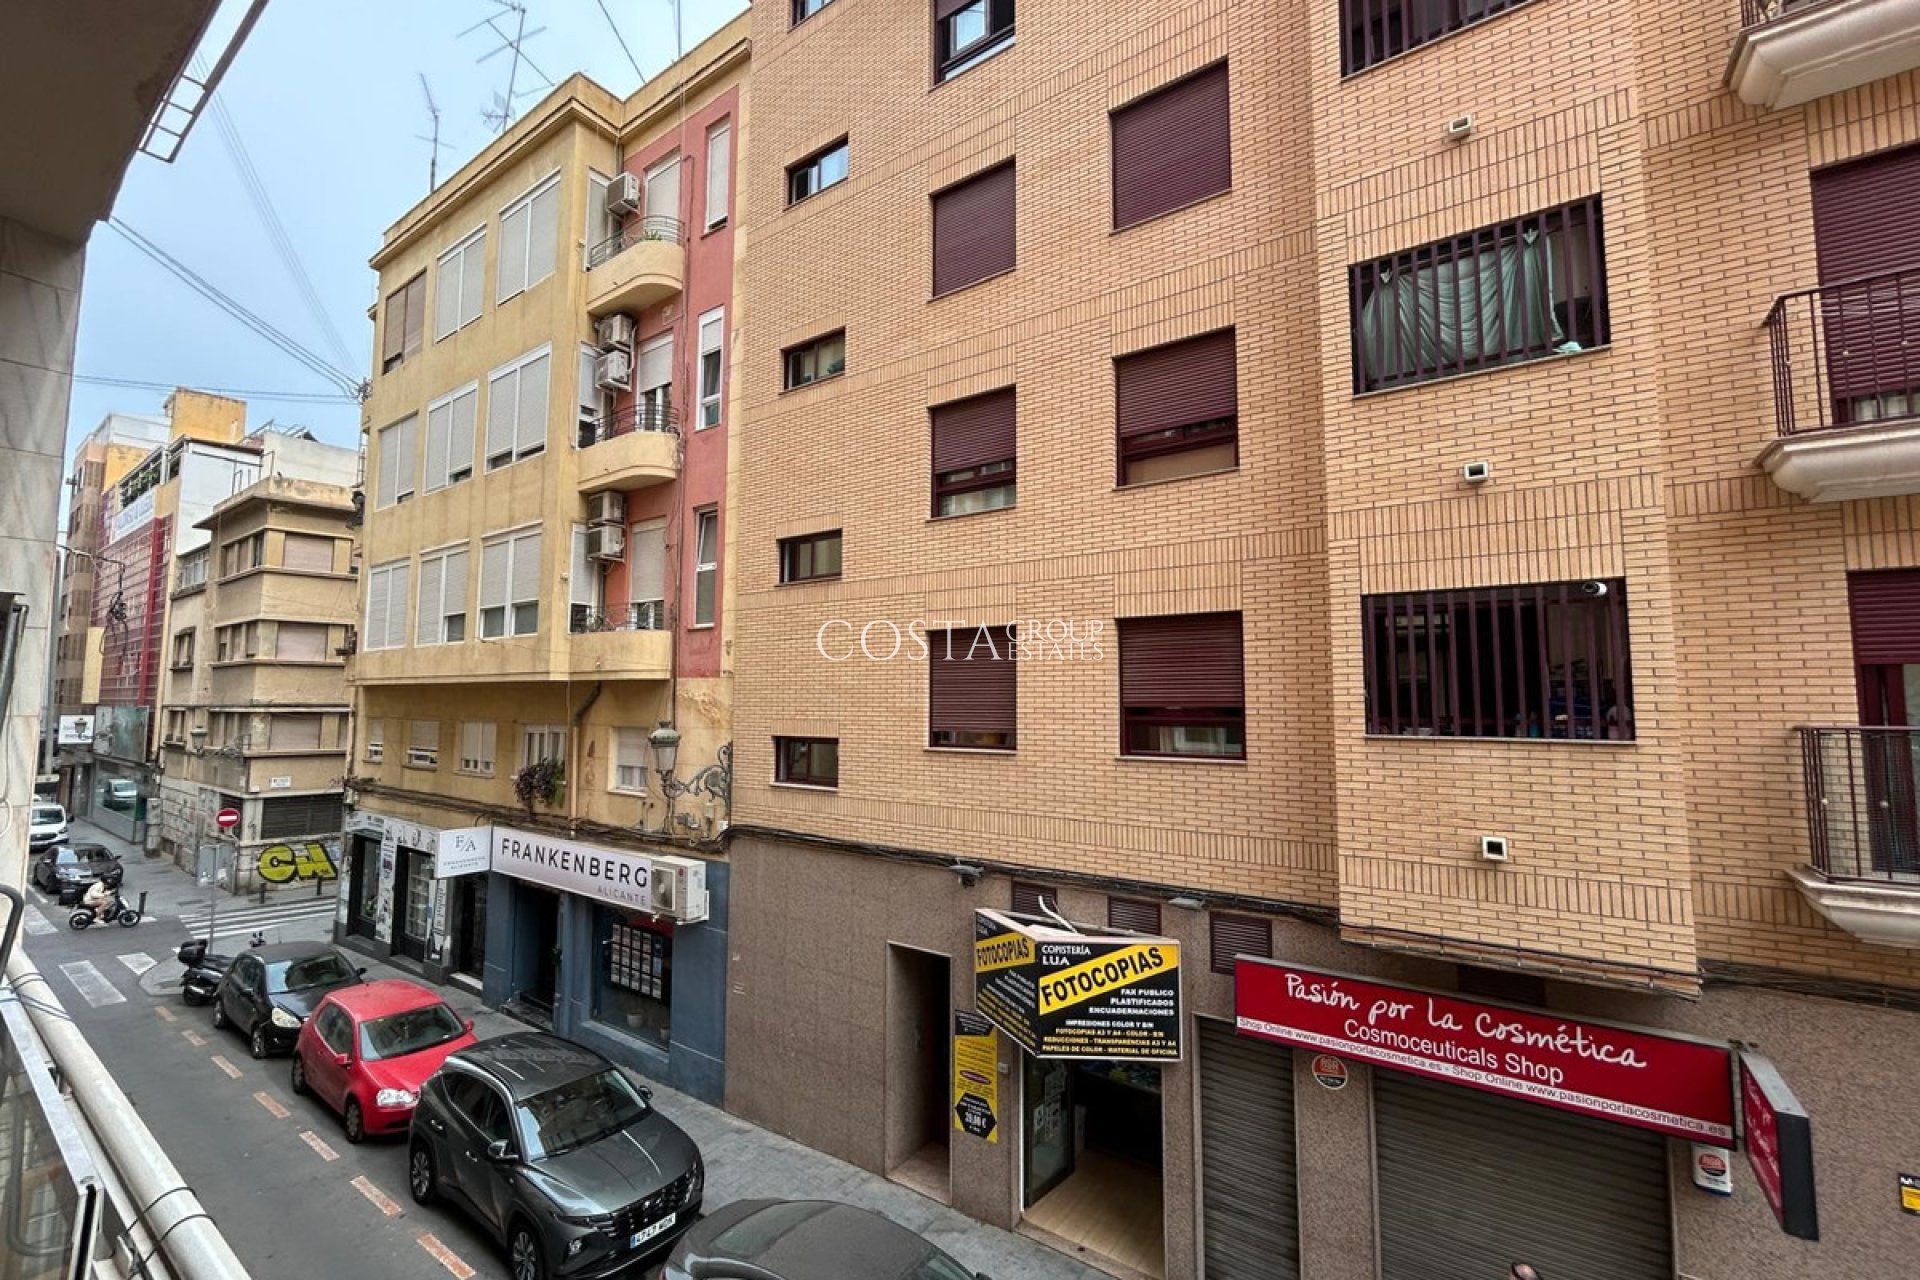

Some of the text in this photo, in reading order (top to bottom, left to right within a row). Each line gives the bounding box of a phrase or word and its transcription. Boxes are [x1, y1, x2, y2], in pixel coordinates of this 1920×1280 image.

[501, 837, 648, 888] FRANKENBERG
[596, 885, 646, 905] ALICANTE
[976, 937, 1030, 968] FOTOCOPIAS
[1042, 956, 1070, 966] LUA
[1040, 946, 1164, 1007] FOTOCOPIAS
[1121, 988, 1174, 997] FAX PUBLICO
[1110, 997, 1174, 1006] PLASTIFICADOS
[1088, 1006, 1175, 1016] ENCUADERNACIONES
[1065, 1019, 1111, 1027] IMPRESIONES
[1111, 1020, 1135, 1028] COLOR
[1284, 973, 1361, 1011] Pasión
[1367, 999, 1414, 1026] por
[1474, 1012, 1648, 1068] Cosmética
[1043, 1036, 1089, 1044] REDUCCIONES
[1093, 1037, 1150, 1046] TRANSPARENCIAS
[1042, 1044, 1070, 1052] PAPELES
[1081, 1045, 1103, 1053] COLOR
[1151, 1048, 1178, 1056] OFICINA
[1343, 1018, 1498, 1070] Cosmoceuticals
[1504, 1052, 1565, 1087] Shop
[1239, 1017, 1263, 1032] Shop
[1263, 1022, 1294, 1039] Online
[1294, 1031, 1442, 1071] www.pasionporlacosmetica.es
[1451, 1063, 1483, 1082] Shop
[1484, 1072, 1524, 1091] Online
[1525, 1082, 1727, 1138] www.pasionporlacosmetica.es
